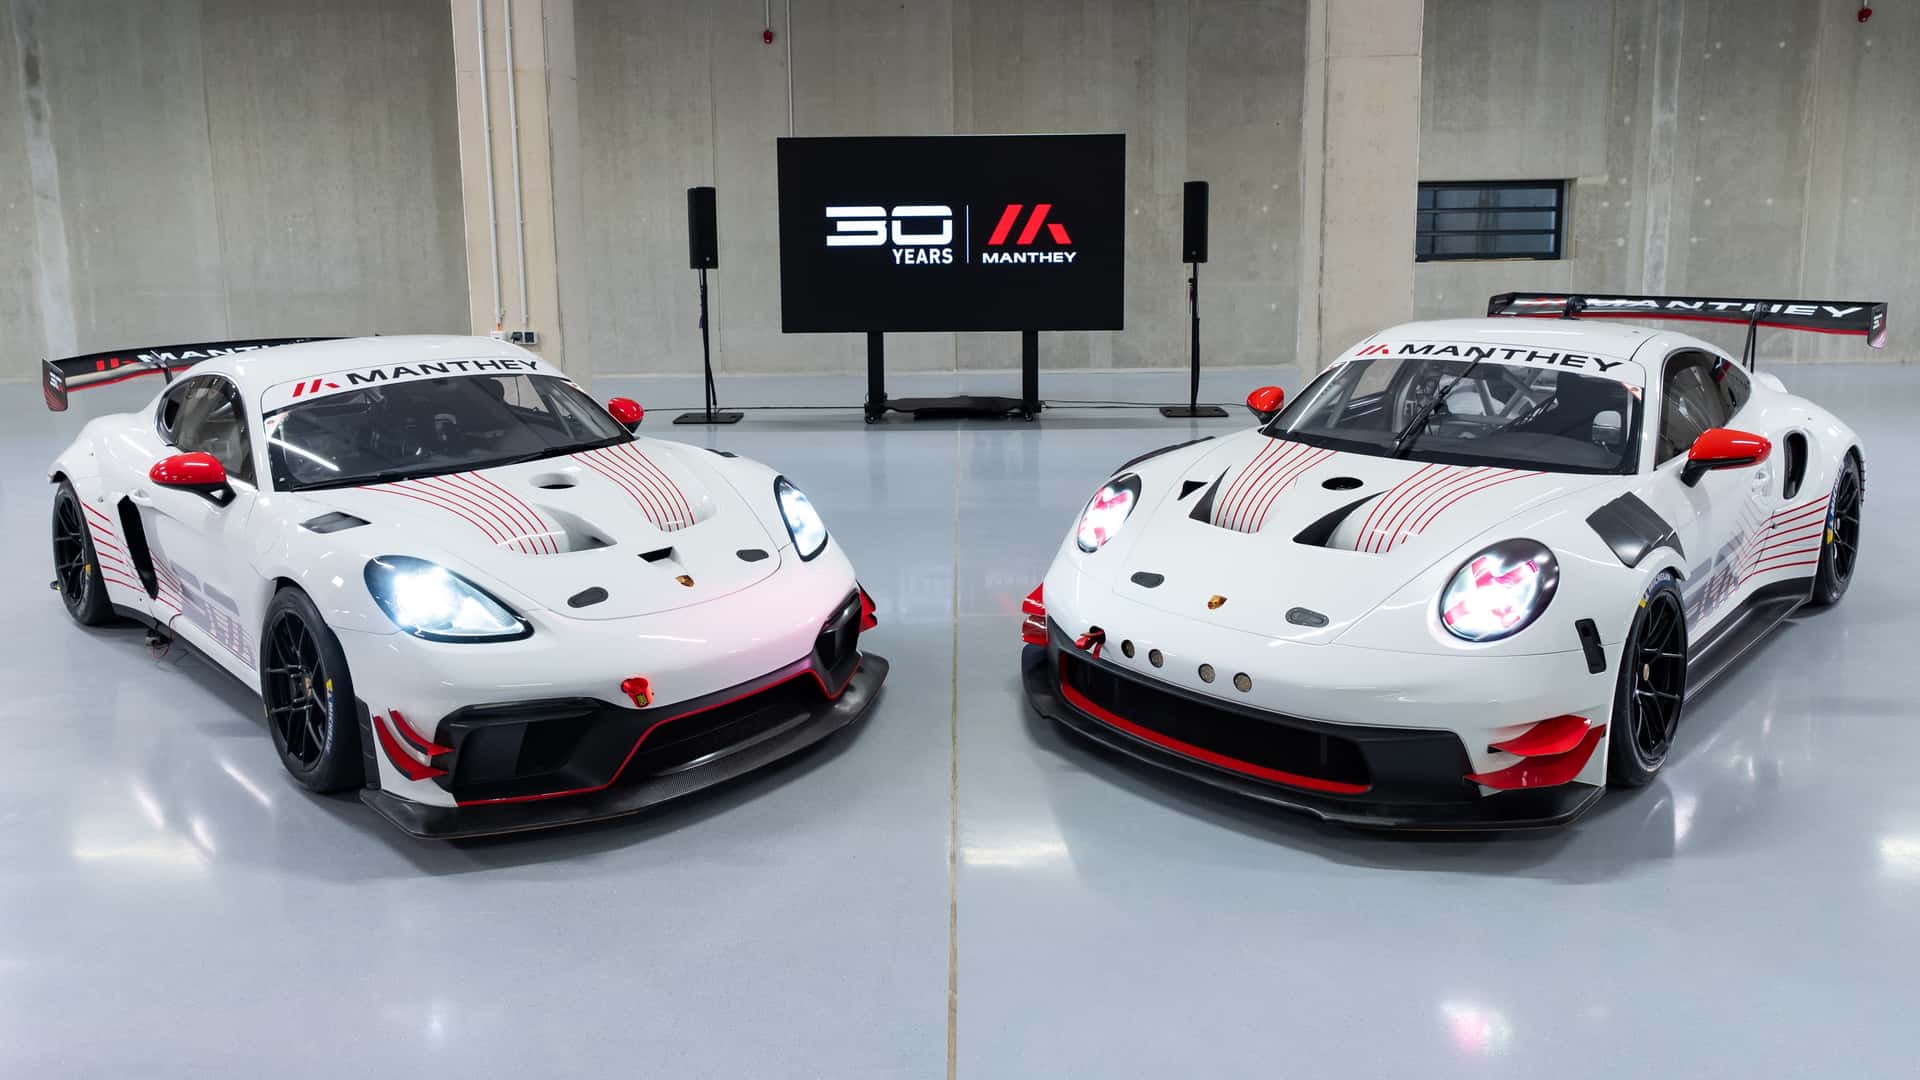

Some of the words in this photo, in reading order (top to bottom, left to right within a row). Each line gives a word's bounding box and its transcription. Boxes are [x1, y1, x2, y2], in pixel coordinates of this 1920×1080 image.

[826, 205, 953, 246] 30
[892, 249, 953, 265] YEARS
[982, 252, 1077, 263] MANTHEY
[1398, 343, 1623, 372] MANTHEY
[346, 359, 537, 385] MANTHEY
